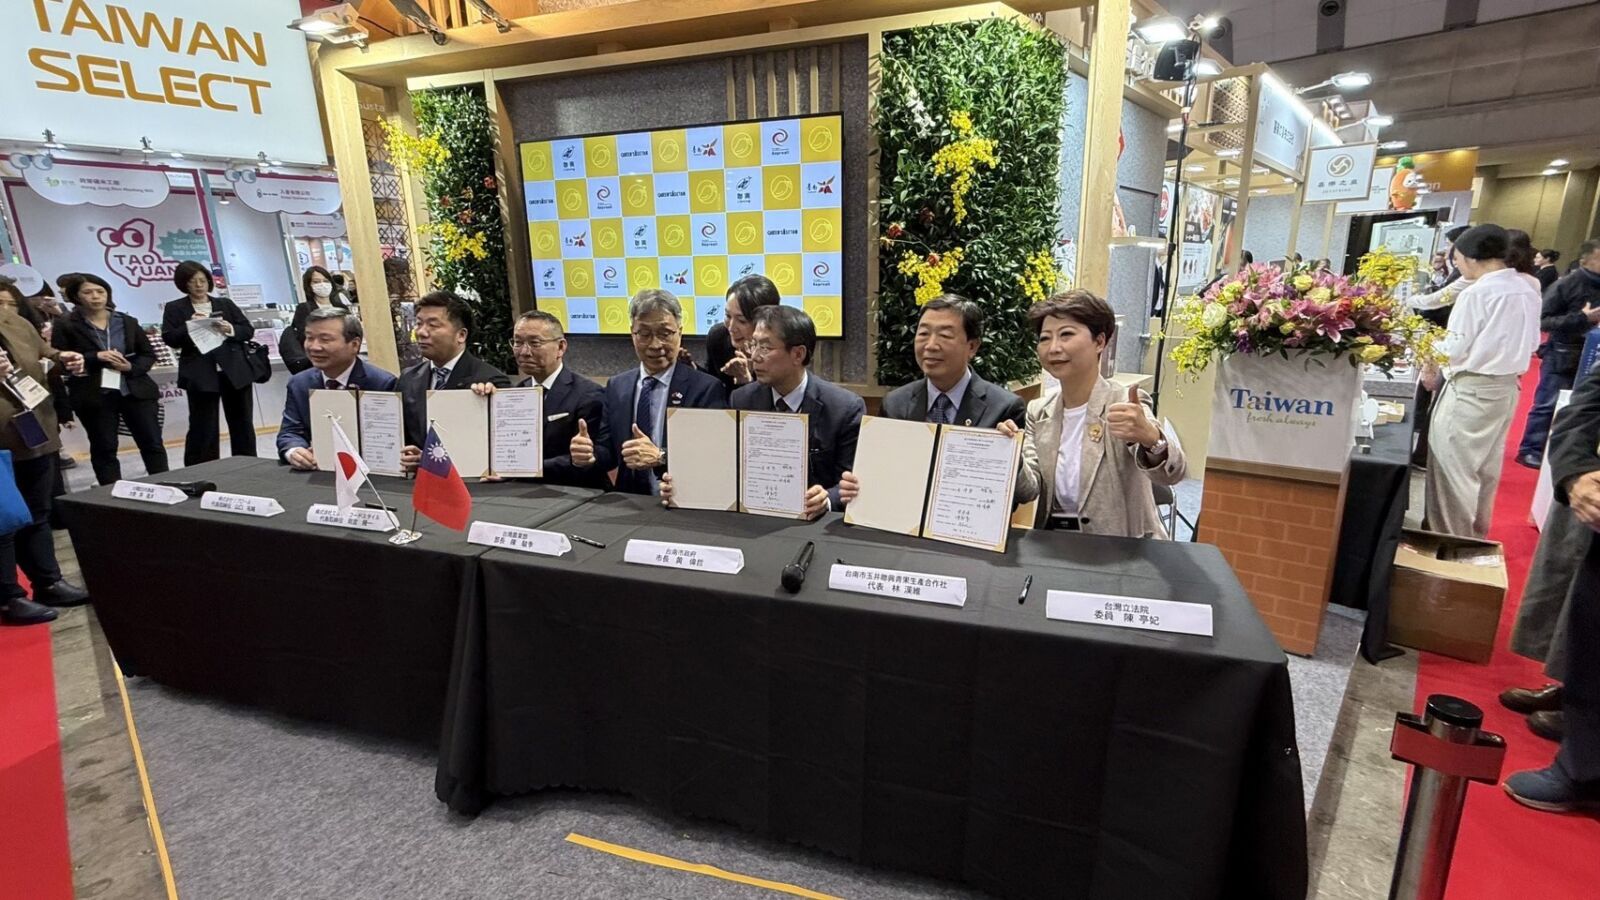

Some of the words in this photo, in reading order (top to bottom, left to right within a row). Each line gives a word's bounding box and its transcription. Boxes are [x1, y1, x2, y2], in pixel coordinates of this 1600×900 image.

[33, 0, 267, 66] TAIWAN
[28, 48, 271, 115] SELECT
[114, 254, 155, 266] TAO
[1230, 388, 1335, 416] Taiwan
[867, 582, 884, 592] 代表
[891, 585, 901, 594] 林
[1104, 601, 1150, 615] 台灣立法院
[1094, 609, 1114, 622] 委員
[1124, 613, 1134, 623] 陳
